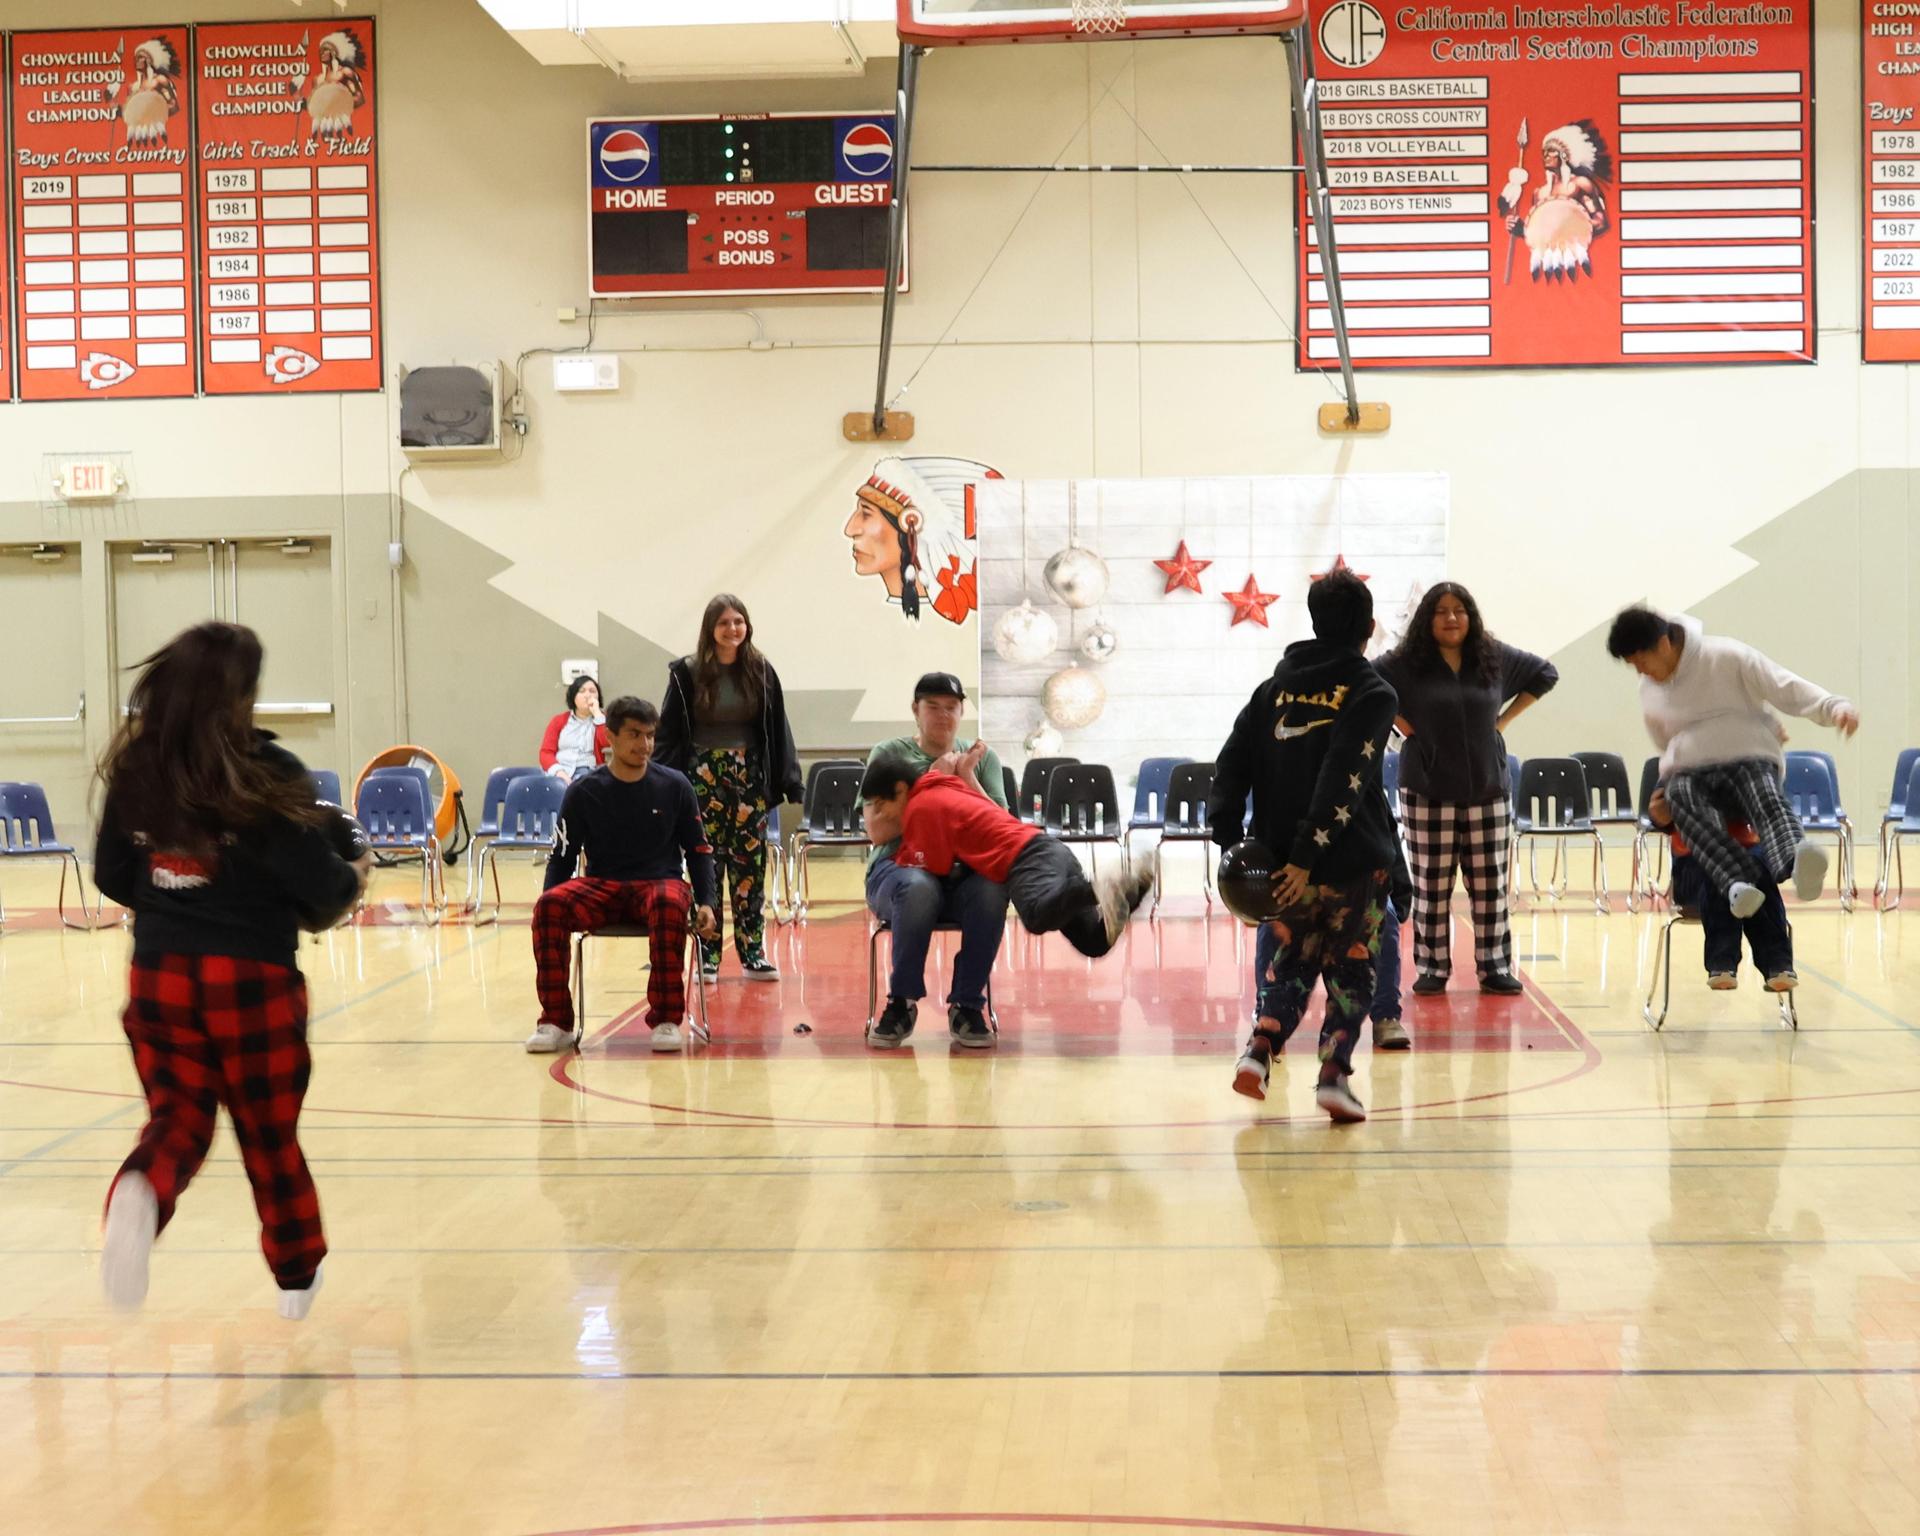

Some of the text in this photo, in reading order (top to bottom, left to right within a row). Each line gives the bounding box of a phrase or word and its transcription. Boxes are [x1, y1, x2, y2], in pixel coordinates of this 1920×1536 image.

[1396, 1, 1794, 31] California Interscholastic Federation
[1871, 23, 1913, 36] HIGH
[205, 44, 307, 59] CHOWCHILLA
[1432, 33, 1758, 62] Central Section Champions
[21, 51, 121, 67] CHOWCHILLA
[20, 69, 125, 86] HIGH SCHOOL
[204, 62, 310, 78] HIGH SCHOOL
[43, 88, 101, 104] LEAGUE
[227, 81, 286, 96] LEAGUE
[1345, 84, 1385, 97] GIRLS
[1389, 82, 1478, 96] BASKETBALL
[27, 107, 119, 123] CHAMPIONS
[211, 100, 303, 116] CHAMPIONS
[1868, 101, 1914, 125] Boys
[1339, 113, 1373, 126] BOYS
[1376, 111, 1420, 125] CROSS
[1422, 110, 1482, 124] COUNTRY
[202, 136, 372, 160] Girls Track & Field
[1329, 140, 1466, 154] 2018 VOLLEYBALL
[1880, 136, 1915, 149] 1978
[17, 146, 187, 169] Boys Cross Country
[1335, 170, 1460, 184] 2019 BASEBALL
[1880, 164, 1915, 178] 1982
[31, 181, 64, 194] 2019
[215, 174, 248, 188] 1978
[605, 188, 667, 209] HOME
[715, 190, 775, 206] PERIOD
[814, 183, 889, 204] GUEST
[1880, 194, 1915, 207] 1986
[216, 202, 247, 215] 1981
[1340, 197, 1452, 211] 2023 BOYS TENNIS
[1880, 223, 1915, 236] 1987
[217, 231, 249, 244] 1982
[723, 230, 769, 246] POSS
[217, 259, 249, 272] 1984
[718, 250, 775, 266] BONUS
[1883, 253, 1914, 266] 2022
[218, 288, 250, 301] 1986
[1883, 282, 1914, 295] 2023
[219, 316, 251, 329] 1987
[73, 465, 104, 490] EXIT
